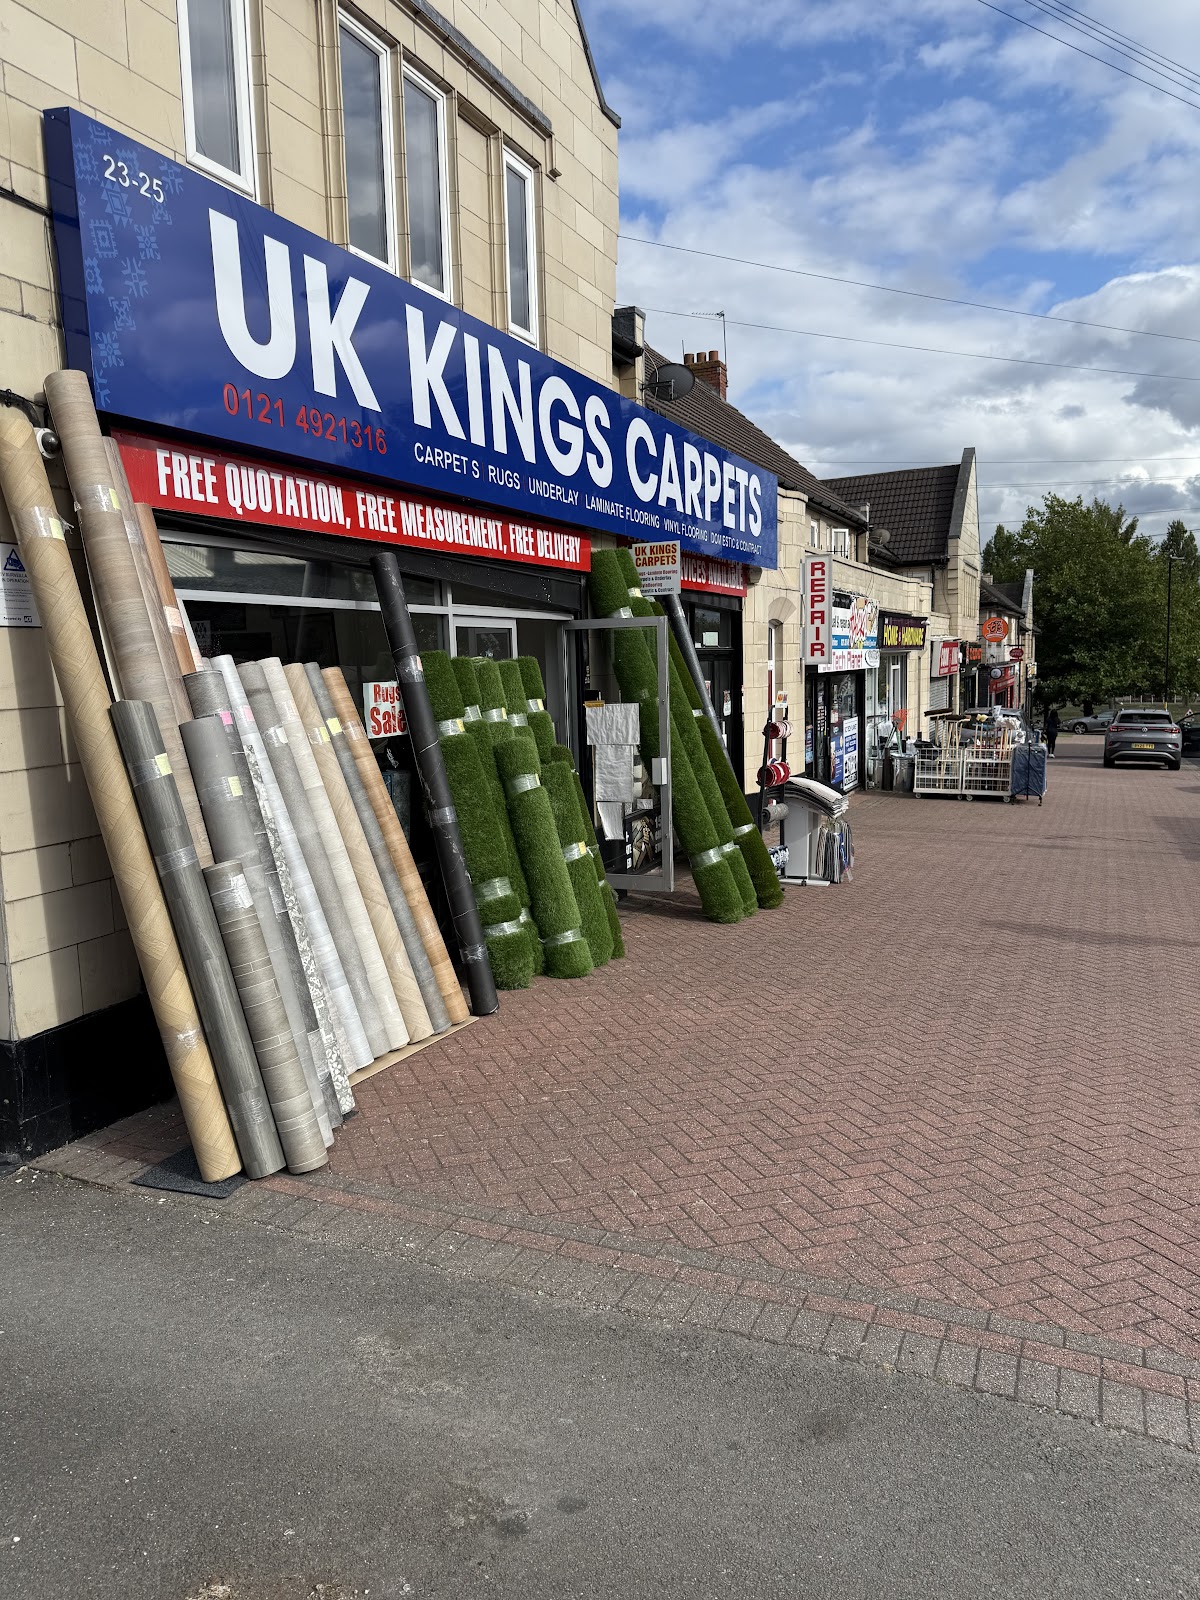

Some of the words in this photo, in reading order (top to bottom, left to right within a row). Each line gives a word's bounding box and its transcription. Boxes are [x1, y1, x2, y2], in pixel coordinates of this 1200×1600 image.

[102, 154, 165, 204] 23-25
[208, 207, 382, 413] UK
[405, 303, 614, 489] KINGS
[625, 417, 763, 537] CARPETS
[222, 383, 285, 428] 0121
[295, 405, 387, 455] 4921316
[156, 448, 219, 504] FREE
[224, 462, 351, 530] QUOTATION,
[355, 490, 398, 534] FREE
[399, 499, 507, 554] MEASUREMENT,
[508, 522, 535, 556] FREE
[536, 527, 581, 564] DELIVERY
[487, 464, 521, 491] RUGS
[528, 476, 579, 506] UNDERLAY
[585, 493, 625, 519] LAMINATE
[625, 506, 660, 529] FLOORING
[663, 517, 681, 535] VINYL
[681, 522, 708, 541] FLOORING
[739, 540, 762, 556] CONTRACT
[634, 545, 647, 557] UK
[649, 543, 677, 556] KINGS
[635, 554, 677, 568] CARPETS
[810, 561, 825, 657] REPAIR
[369, 706, 408, 736] Sale
[373, 683, 401, 705] Rugs
